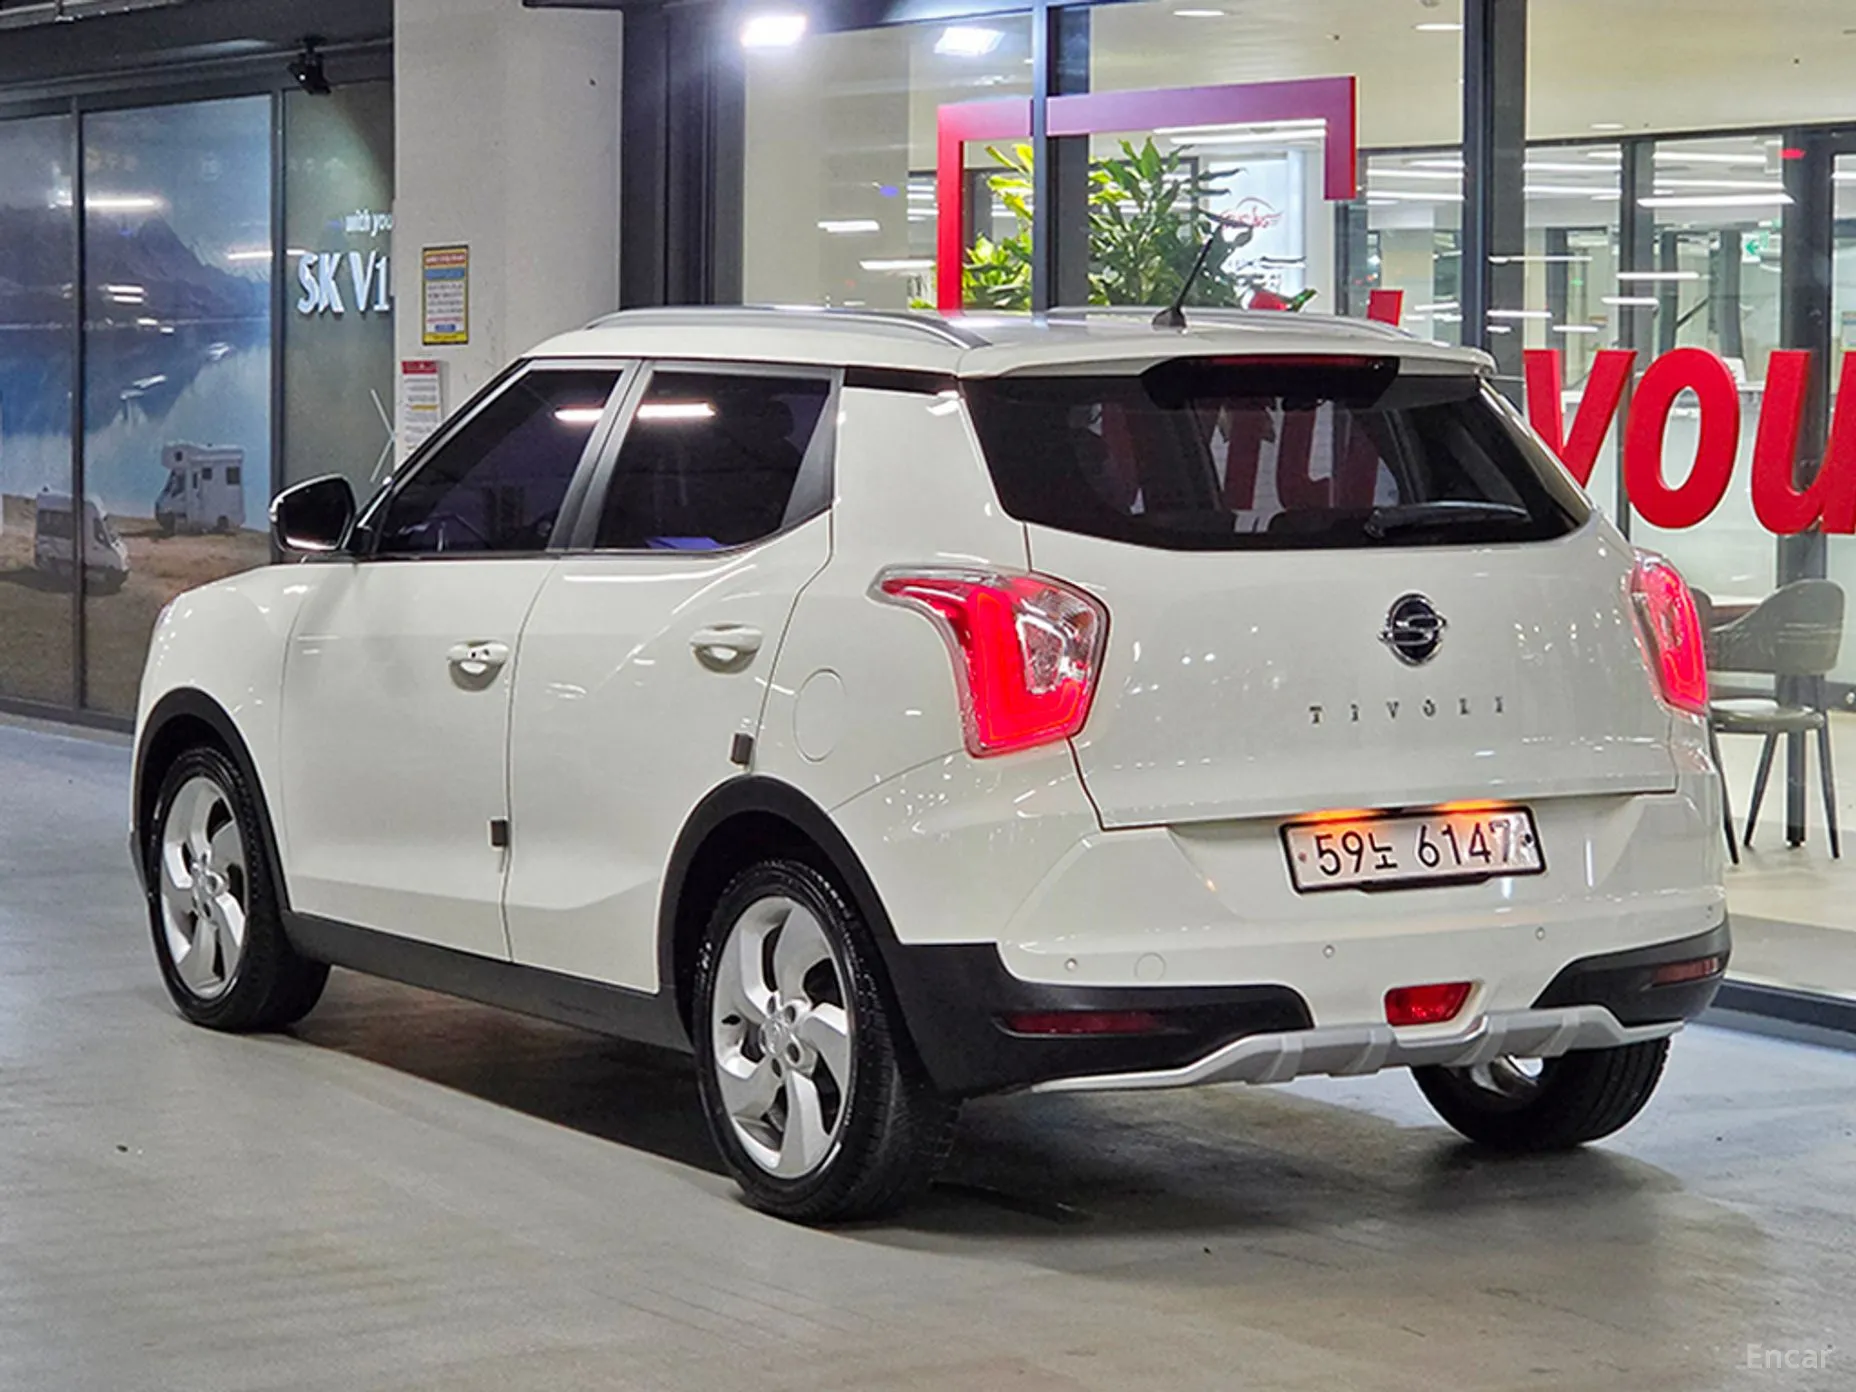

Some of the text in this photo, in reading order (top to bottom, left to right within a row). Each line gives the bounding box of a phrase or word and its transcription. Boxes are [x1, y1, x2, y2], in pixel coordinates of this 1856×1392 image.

[297, 250, 390, 314] SK V1
[1523, 347, 1856, 535] you
[1314, 818, 1511, 877] 59노 6147
